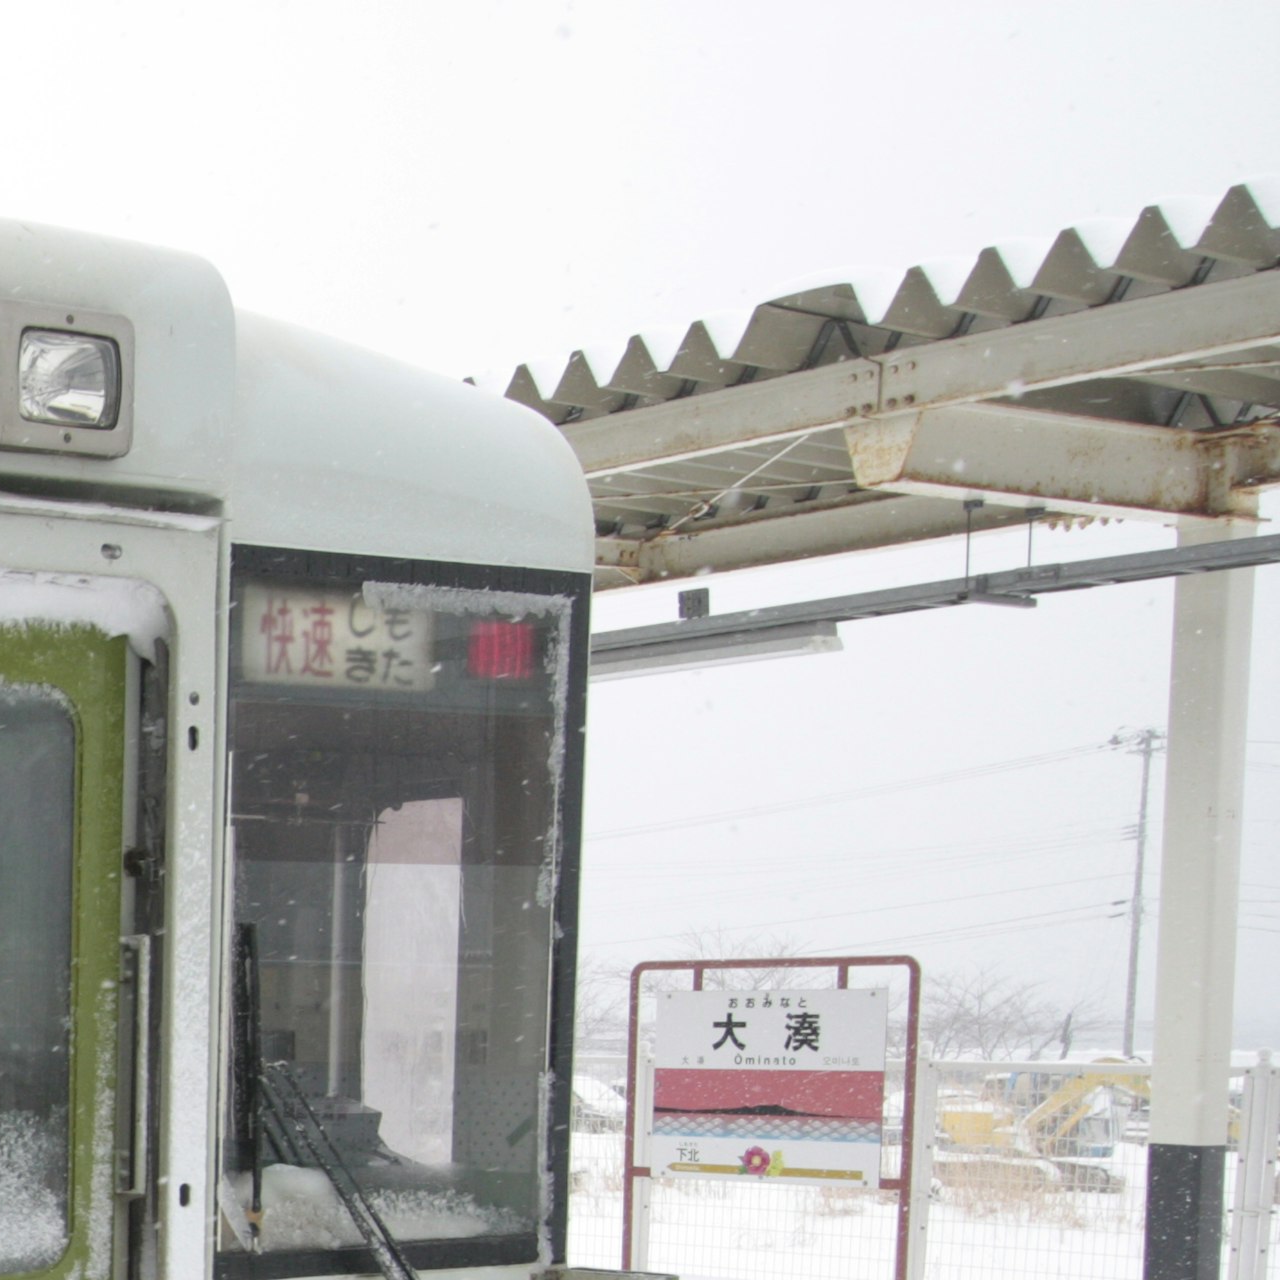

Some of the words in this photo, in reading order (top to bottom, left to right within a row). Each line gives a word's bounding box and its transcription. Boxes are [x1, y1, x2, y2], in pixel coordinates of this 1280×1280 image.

[260, 599, 335, 678] 快速
[712, 1012, 820, 1052] 大湊
[676, 1148, 700, 1162] 下北
